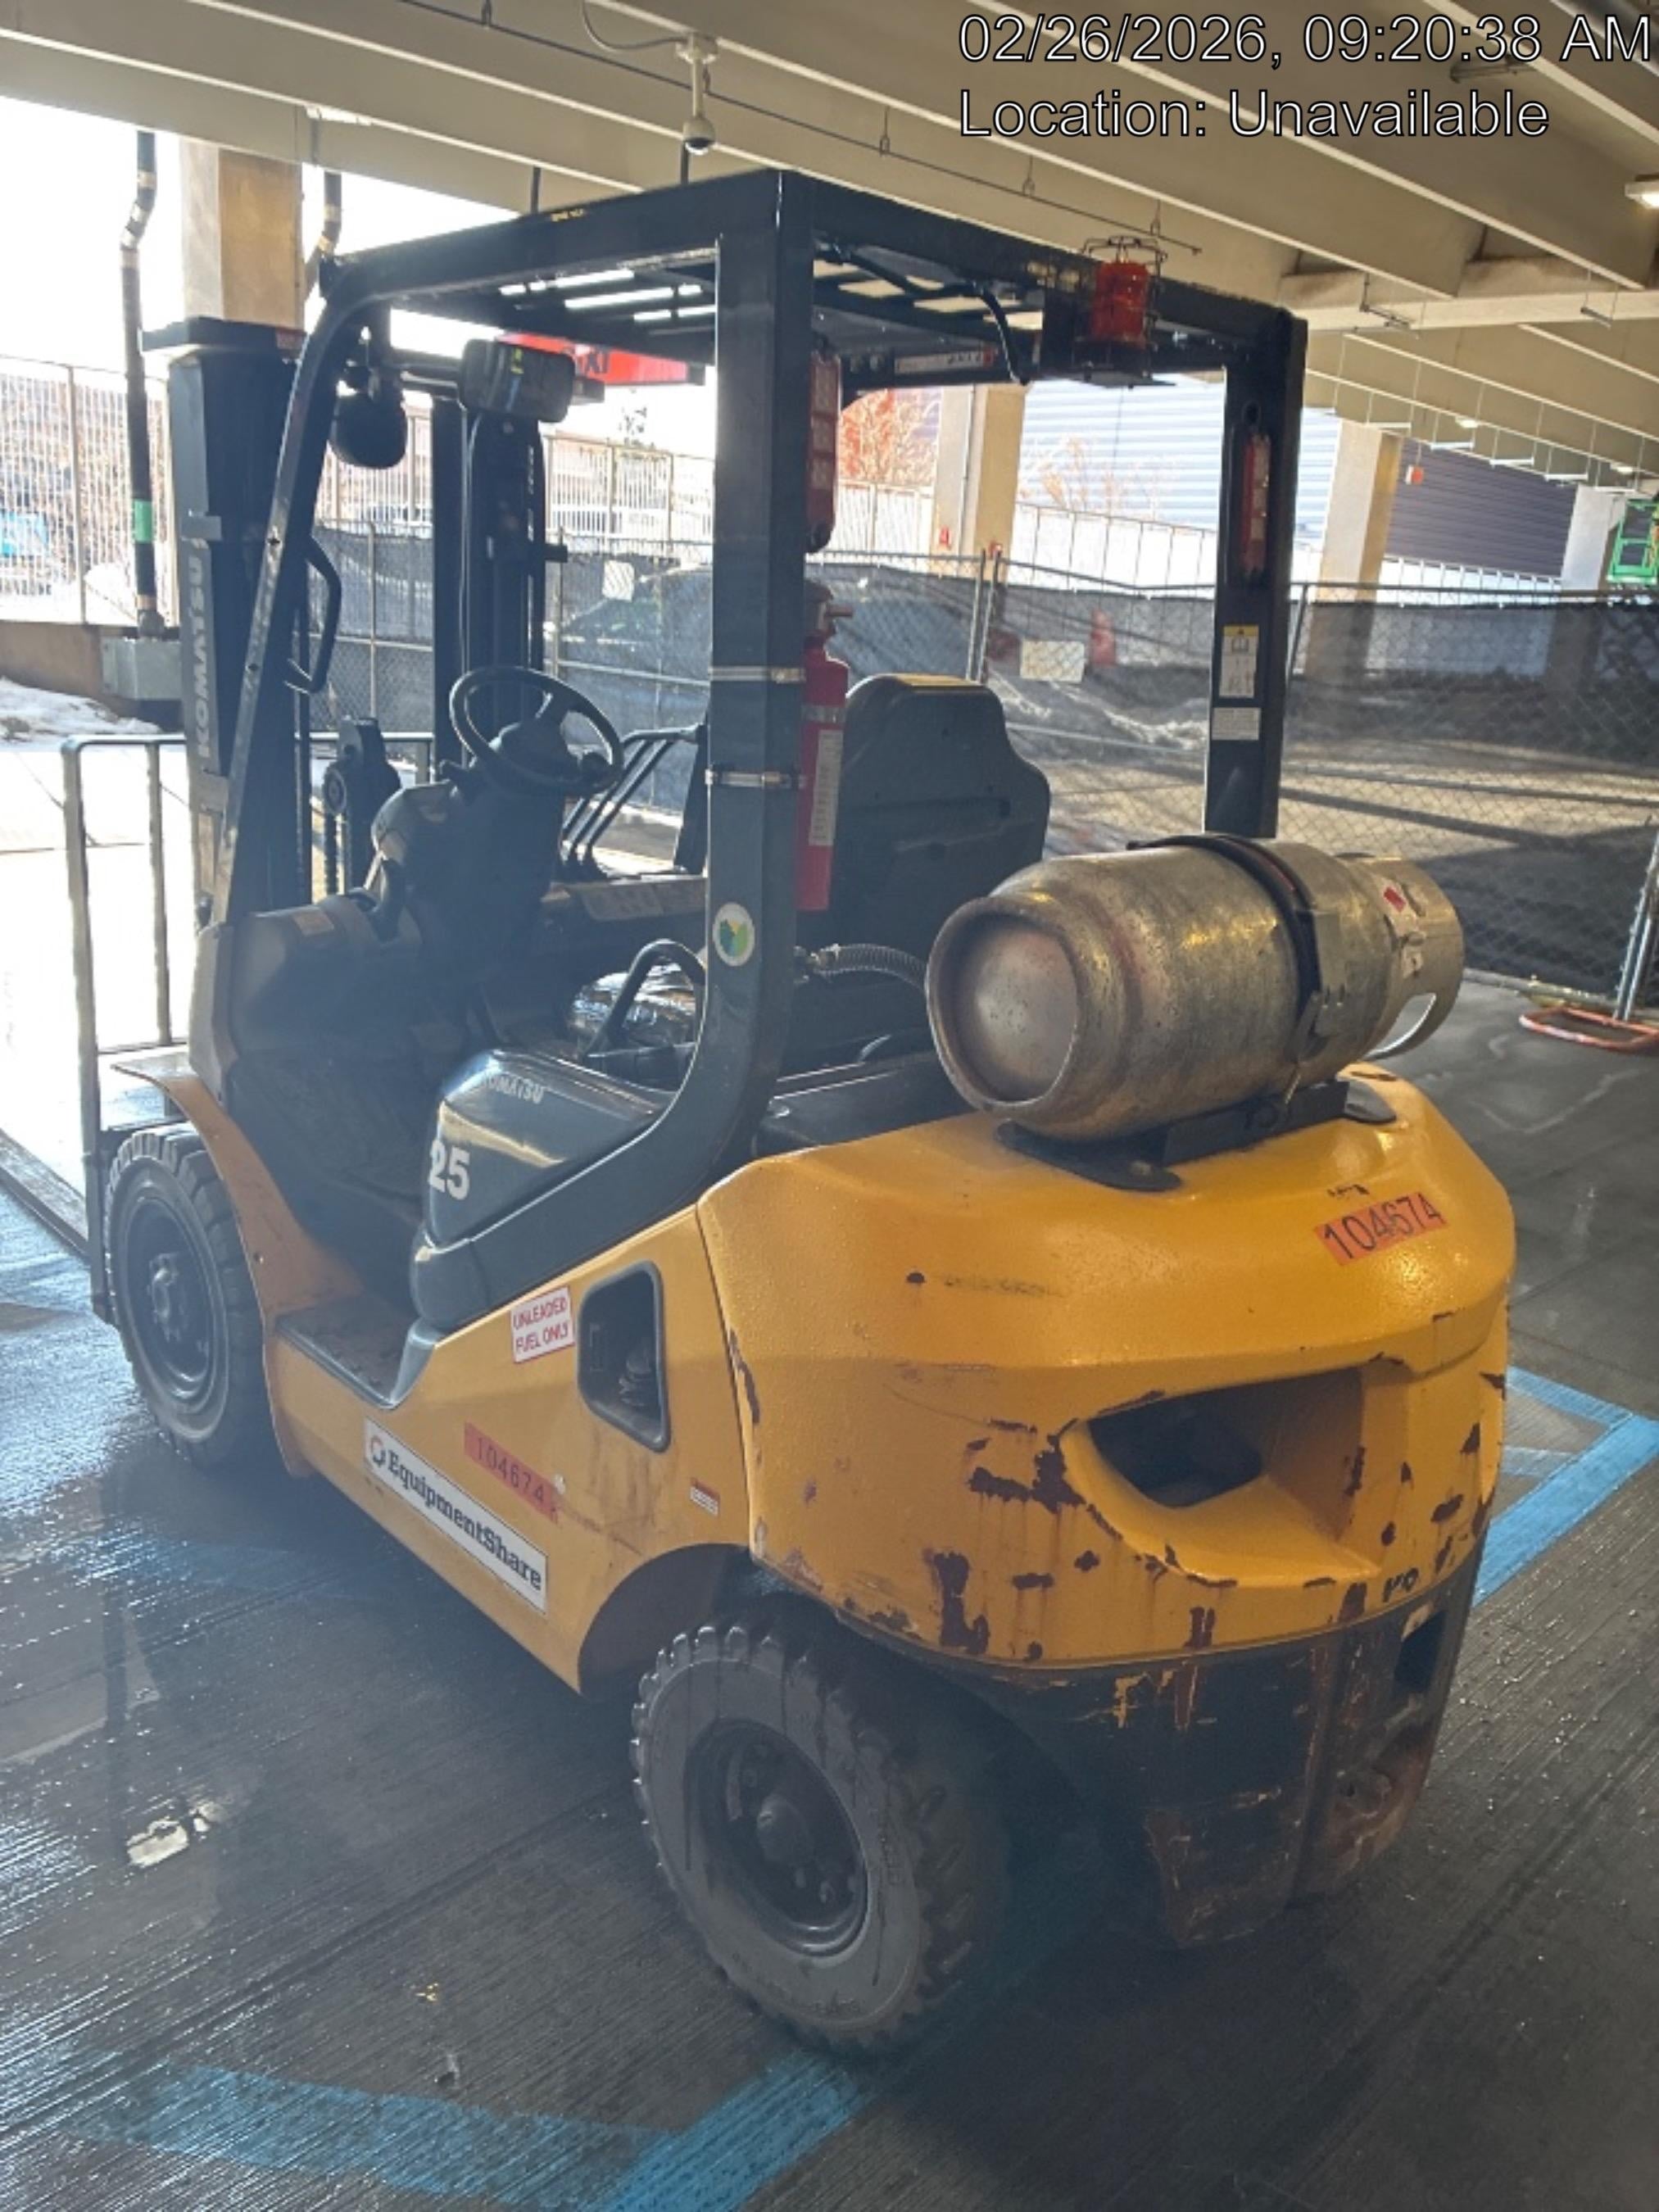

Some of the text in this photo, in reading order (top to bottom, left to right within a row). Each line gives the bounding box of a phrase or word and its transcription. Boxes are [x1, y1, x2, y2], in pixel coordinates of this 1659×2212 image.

[428, 1139, 470, 1200] 25
[1323, 1191, 1448, 1260] 104674
[513, 1297, 567, 1330] UNLEADED
[515, 1321, 569, 1353] FUEL ONLY
[478, 1436, 545, 1504] 104674
[388, 1448, 542, 1591] EquipmentShare
